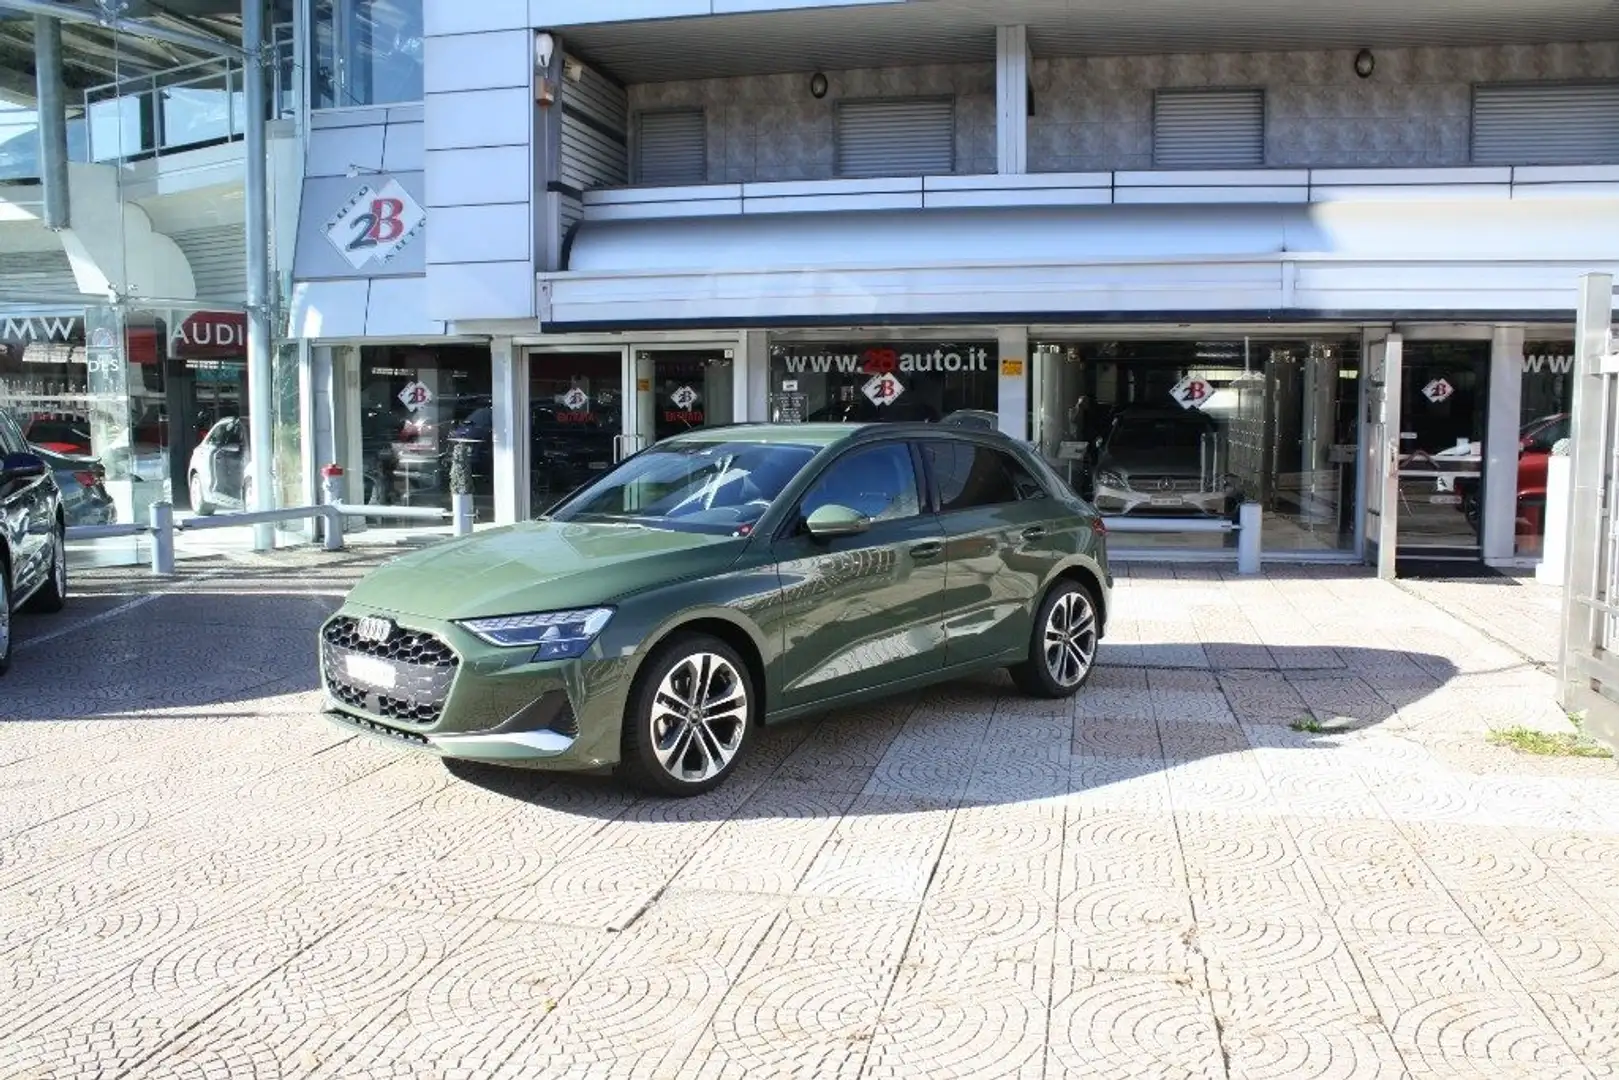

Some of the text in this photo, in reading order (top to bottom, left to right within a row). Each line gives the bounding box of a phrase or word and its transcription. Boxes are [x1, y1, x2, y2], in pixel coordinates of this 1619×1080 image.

[326, 185, 369, 231] AUTO
[345, 197, 405, 252] 2B
[170, 320, 244, 346] AUDI
[784, 346, 988, 374] www.2Bauto.it
[408, 386, 427, 404] 2B
[873, 379, 896, 399] 2B
[1182, 380, 1206, 402] 2B
